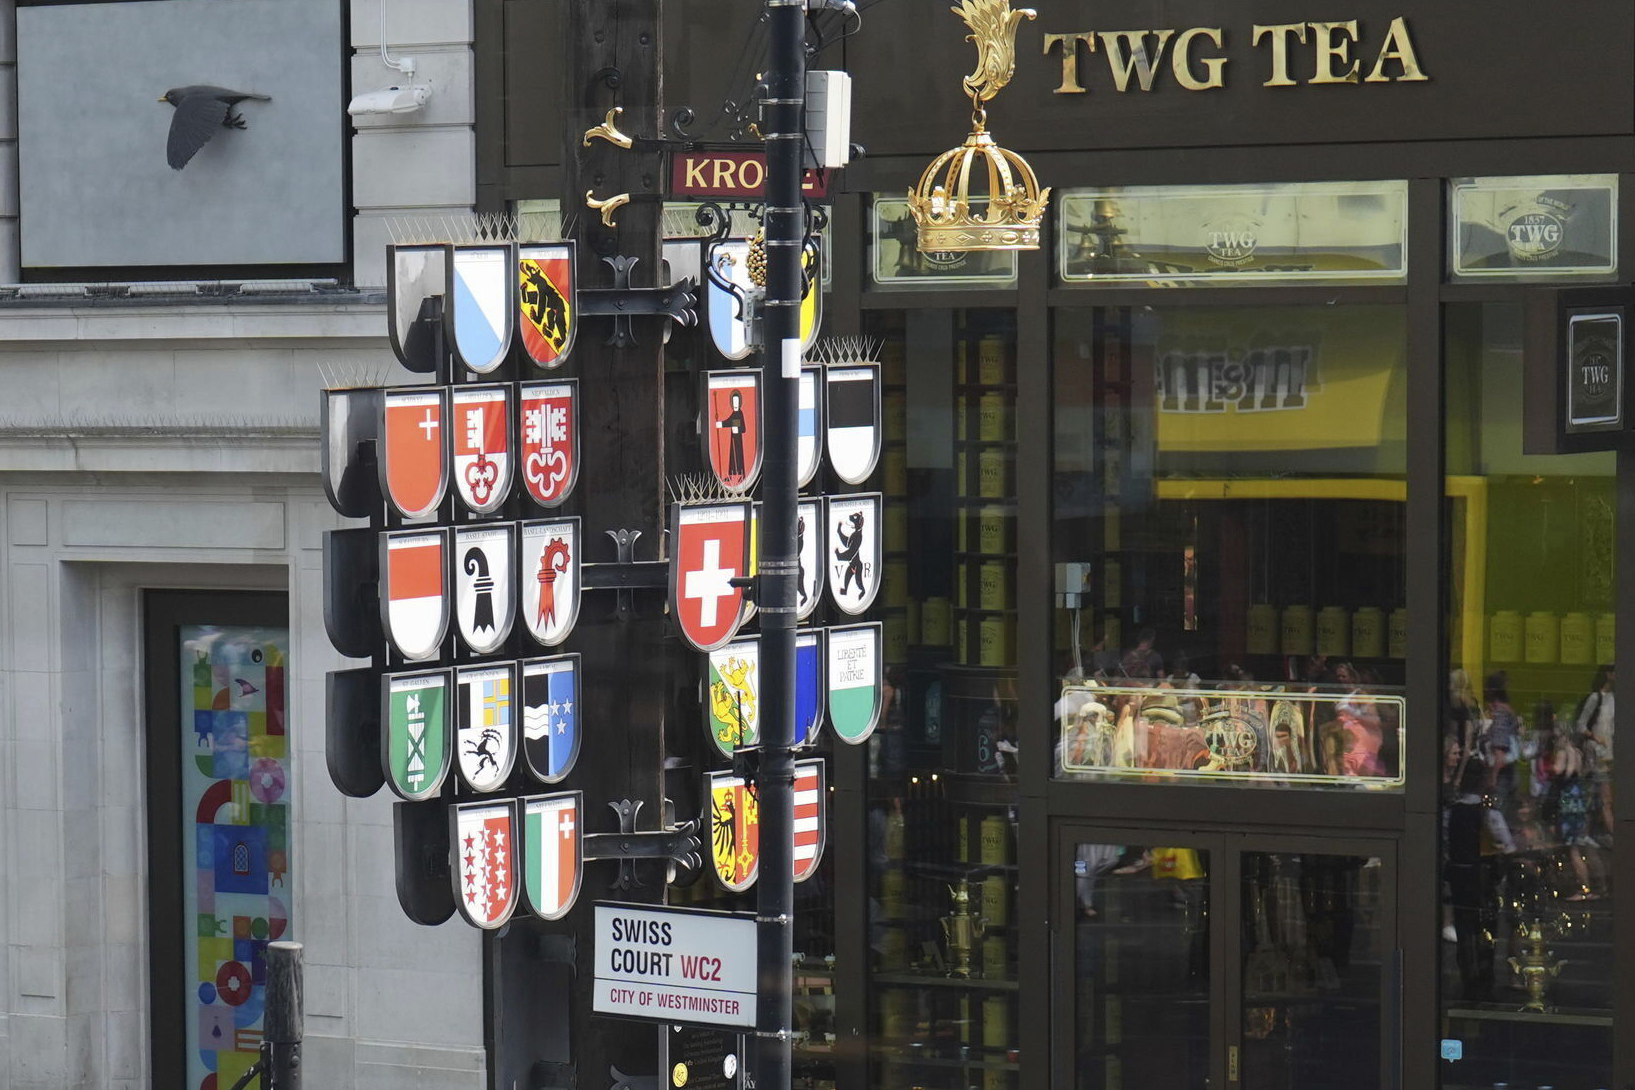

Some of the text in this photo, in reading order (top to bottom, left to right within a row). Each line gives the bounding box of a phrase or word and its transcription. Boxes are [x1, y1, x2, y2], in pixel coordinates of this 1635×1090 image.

[1044, 16, 1428, 94] TWG TEA
[686, 157, 813, 189] KRO
[1209, 231, 1254, 249] TWG
[1511, 225, 1559, 243] TWG
[934, 252, 955, 261] TEA
[1220, 248, 1241, 257] TEA
[1582, 366, 1608, 385] TWG
[835, 561, 872, 580] V R
[847, 659, 857, 671] ET
[612, 917, 672, 946] SWISS
[611, 948, 722, 982] COURT WC2
[610, 988, 739, 1015] CITY OF WESTMINSTER
